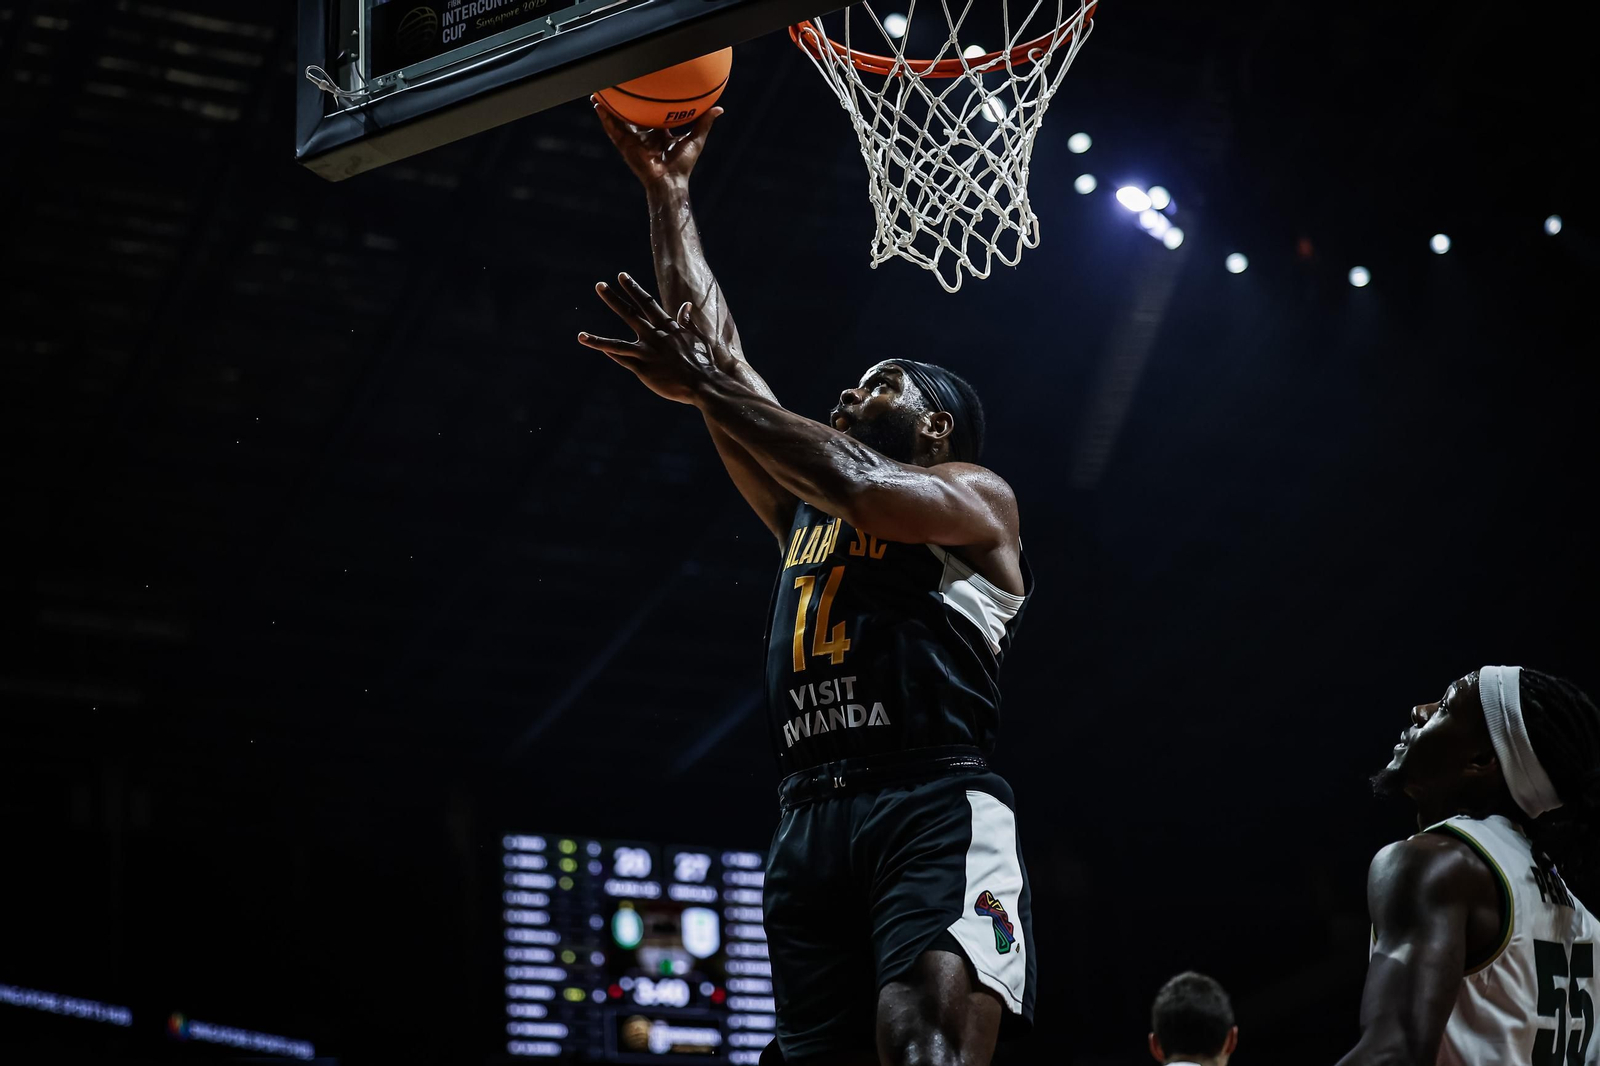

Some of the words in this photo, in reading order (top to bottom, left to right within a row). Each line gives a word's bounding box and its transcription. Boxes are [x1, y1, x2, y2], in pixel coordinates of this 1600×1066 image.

[442, 22, 467, 44] CUP
[475, 7, 520, 30] Singapore
[665, 108, 697, 121] FIBA
[793, 565, 850, 673] 14
[789, 676, 857, 711] VISIT
[783, 702, 891, 748] RWANDA
[1531, 939, 1594, 1066] 55
